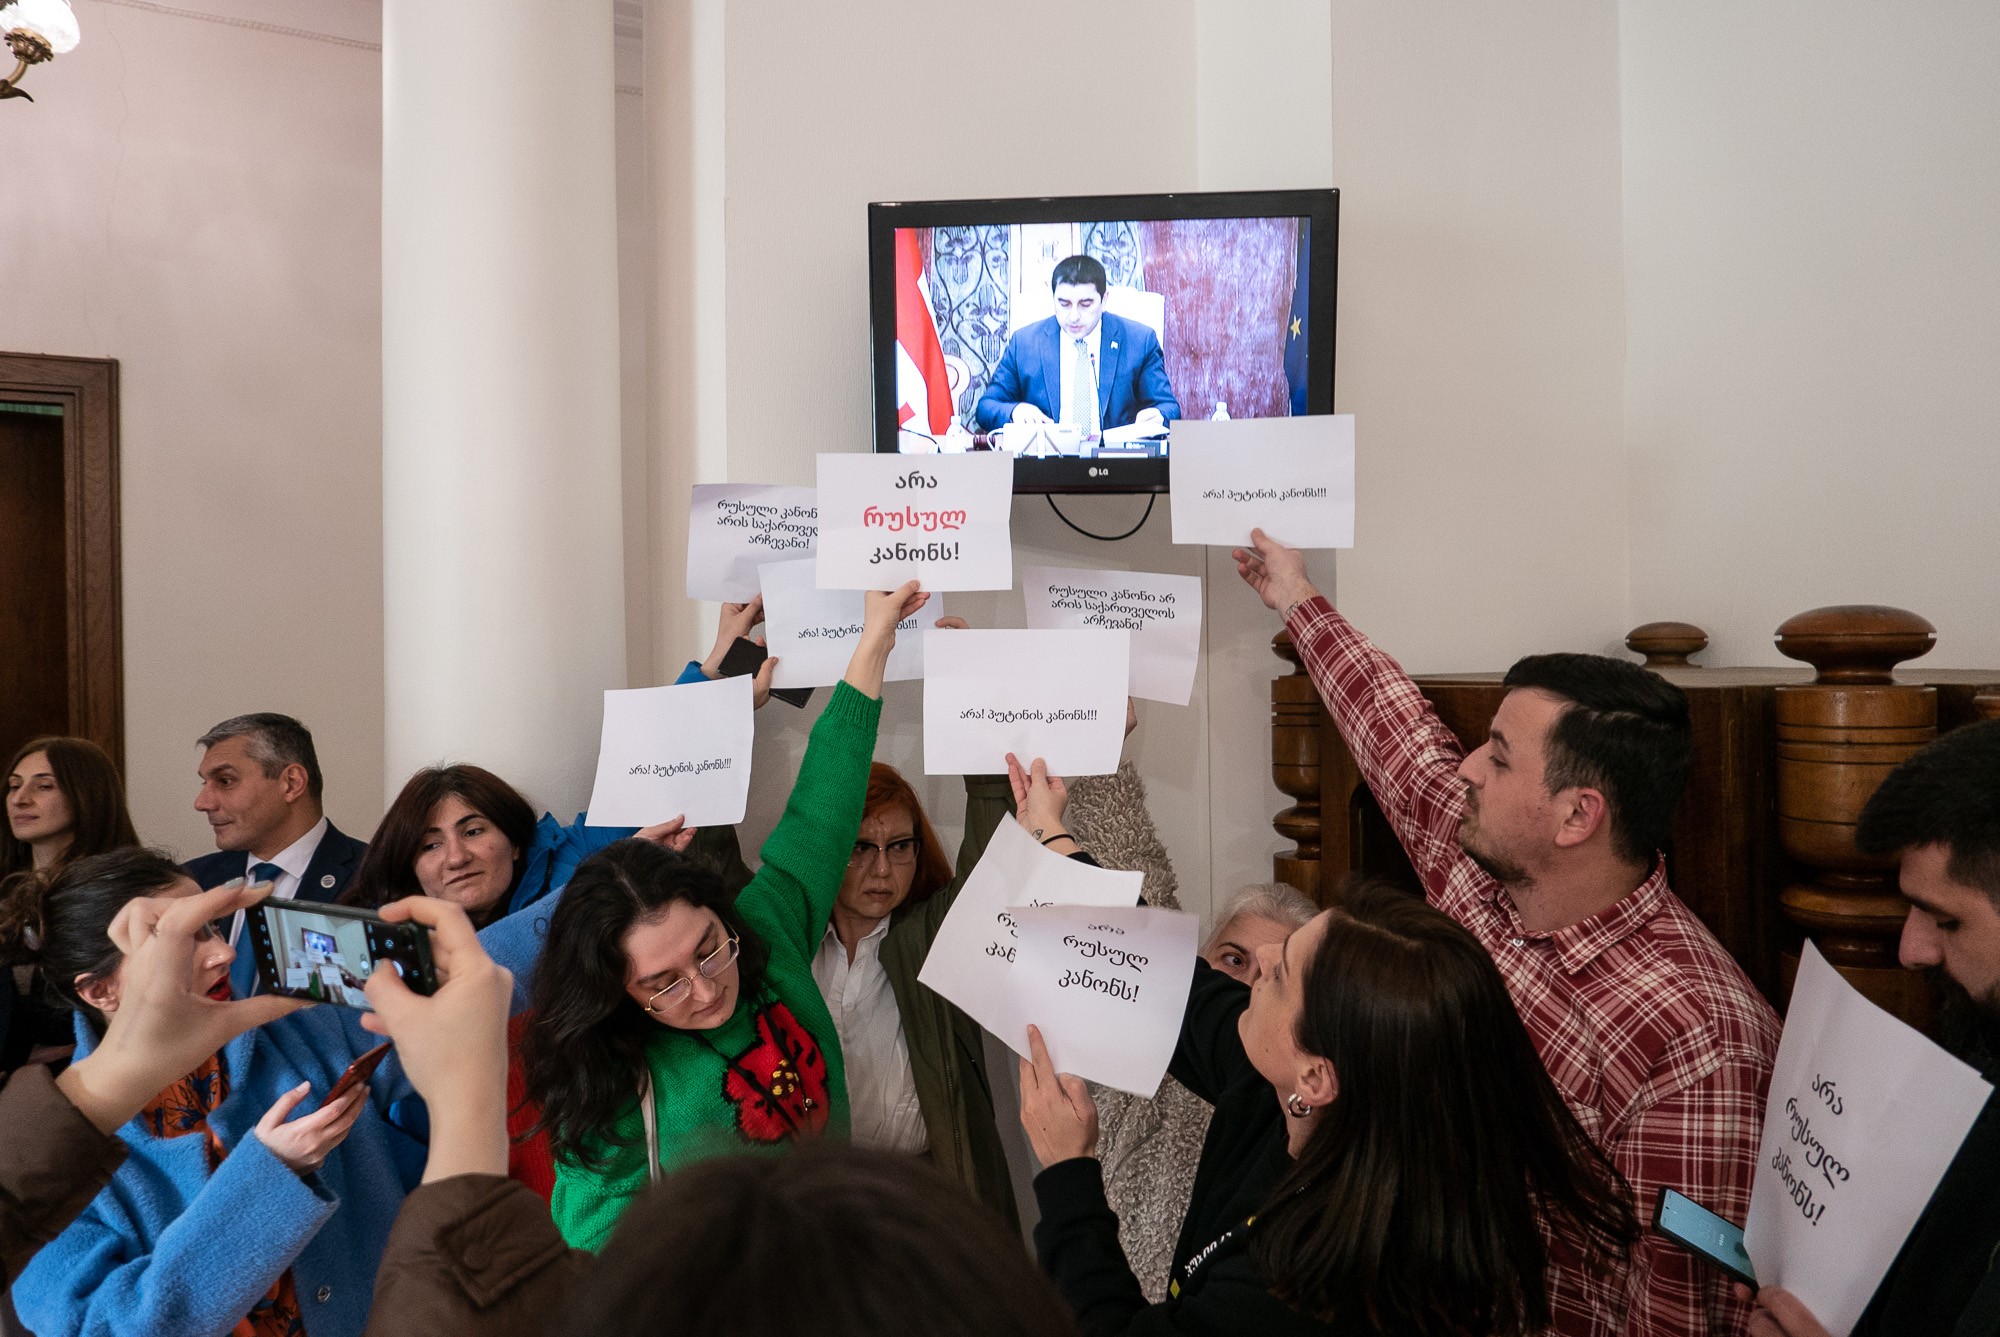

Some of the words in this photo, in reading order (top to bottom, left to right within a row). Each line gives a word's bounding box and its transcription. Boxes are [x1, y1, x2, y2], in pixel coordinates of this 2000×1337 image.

[895, 471, 938, 490] არა
[1098, 468, 1109, 476] LG
[1202, 489, 1225, 499] არა!
[1227, 488, 1277, 502] პუტინის
[1279, 487, 1327, 501] კანონს!!!
[717, 500, 778, 517] რუსული
[717, 514, 749, 528] არის
[864, 506, 967, 531] რუსულ
[748, 534, 811, 550] არჩევანი!
[869, 542, 959, 564] კანონს!
[1048, 585, 1108, 600] რუსული
[1110, 588, 1156, 603] კანონი
[1158, 593, 1176, 604] არ
[1051, 597, 1082, 610] არის
[1084, 599, 1176, 620] საქართველოს
[797, 627, 820, 639] არა!
[821, 623, 865, 639] პუტინი
[959, 708, 985, 720] არა!
[987, 708, 1044, 723] პუტინის
[1046, 709, 1098, 723] კანონს!!!
[628, 764, 651, 775] არა!
[652, 762, 694, 778] პუტინის
[695, 757, 732, 775] კანონს!!!
[1087, 922, 1126, 936] არა
[1062, 934, 1149, 973] რუსულ
[1058, 969, 1141, 1003] კანონს!
[1811, 1073, 1844, 1116] არა
[1785, 1096, 1851, 1190] რუსულ
[1771, 1146, 1827, 1227] კანონს!
